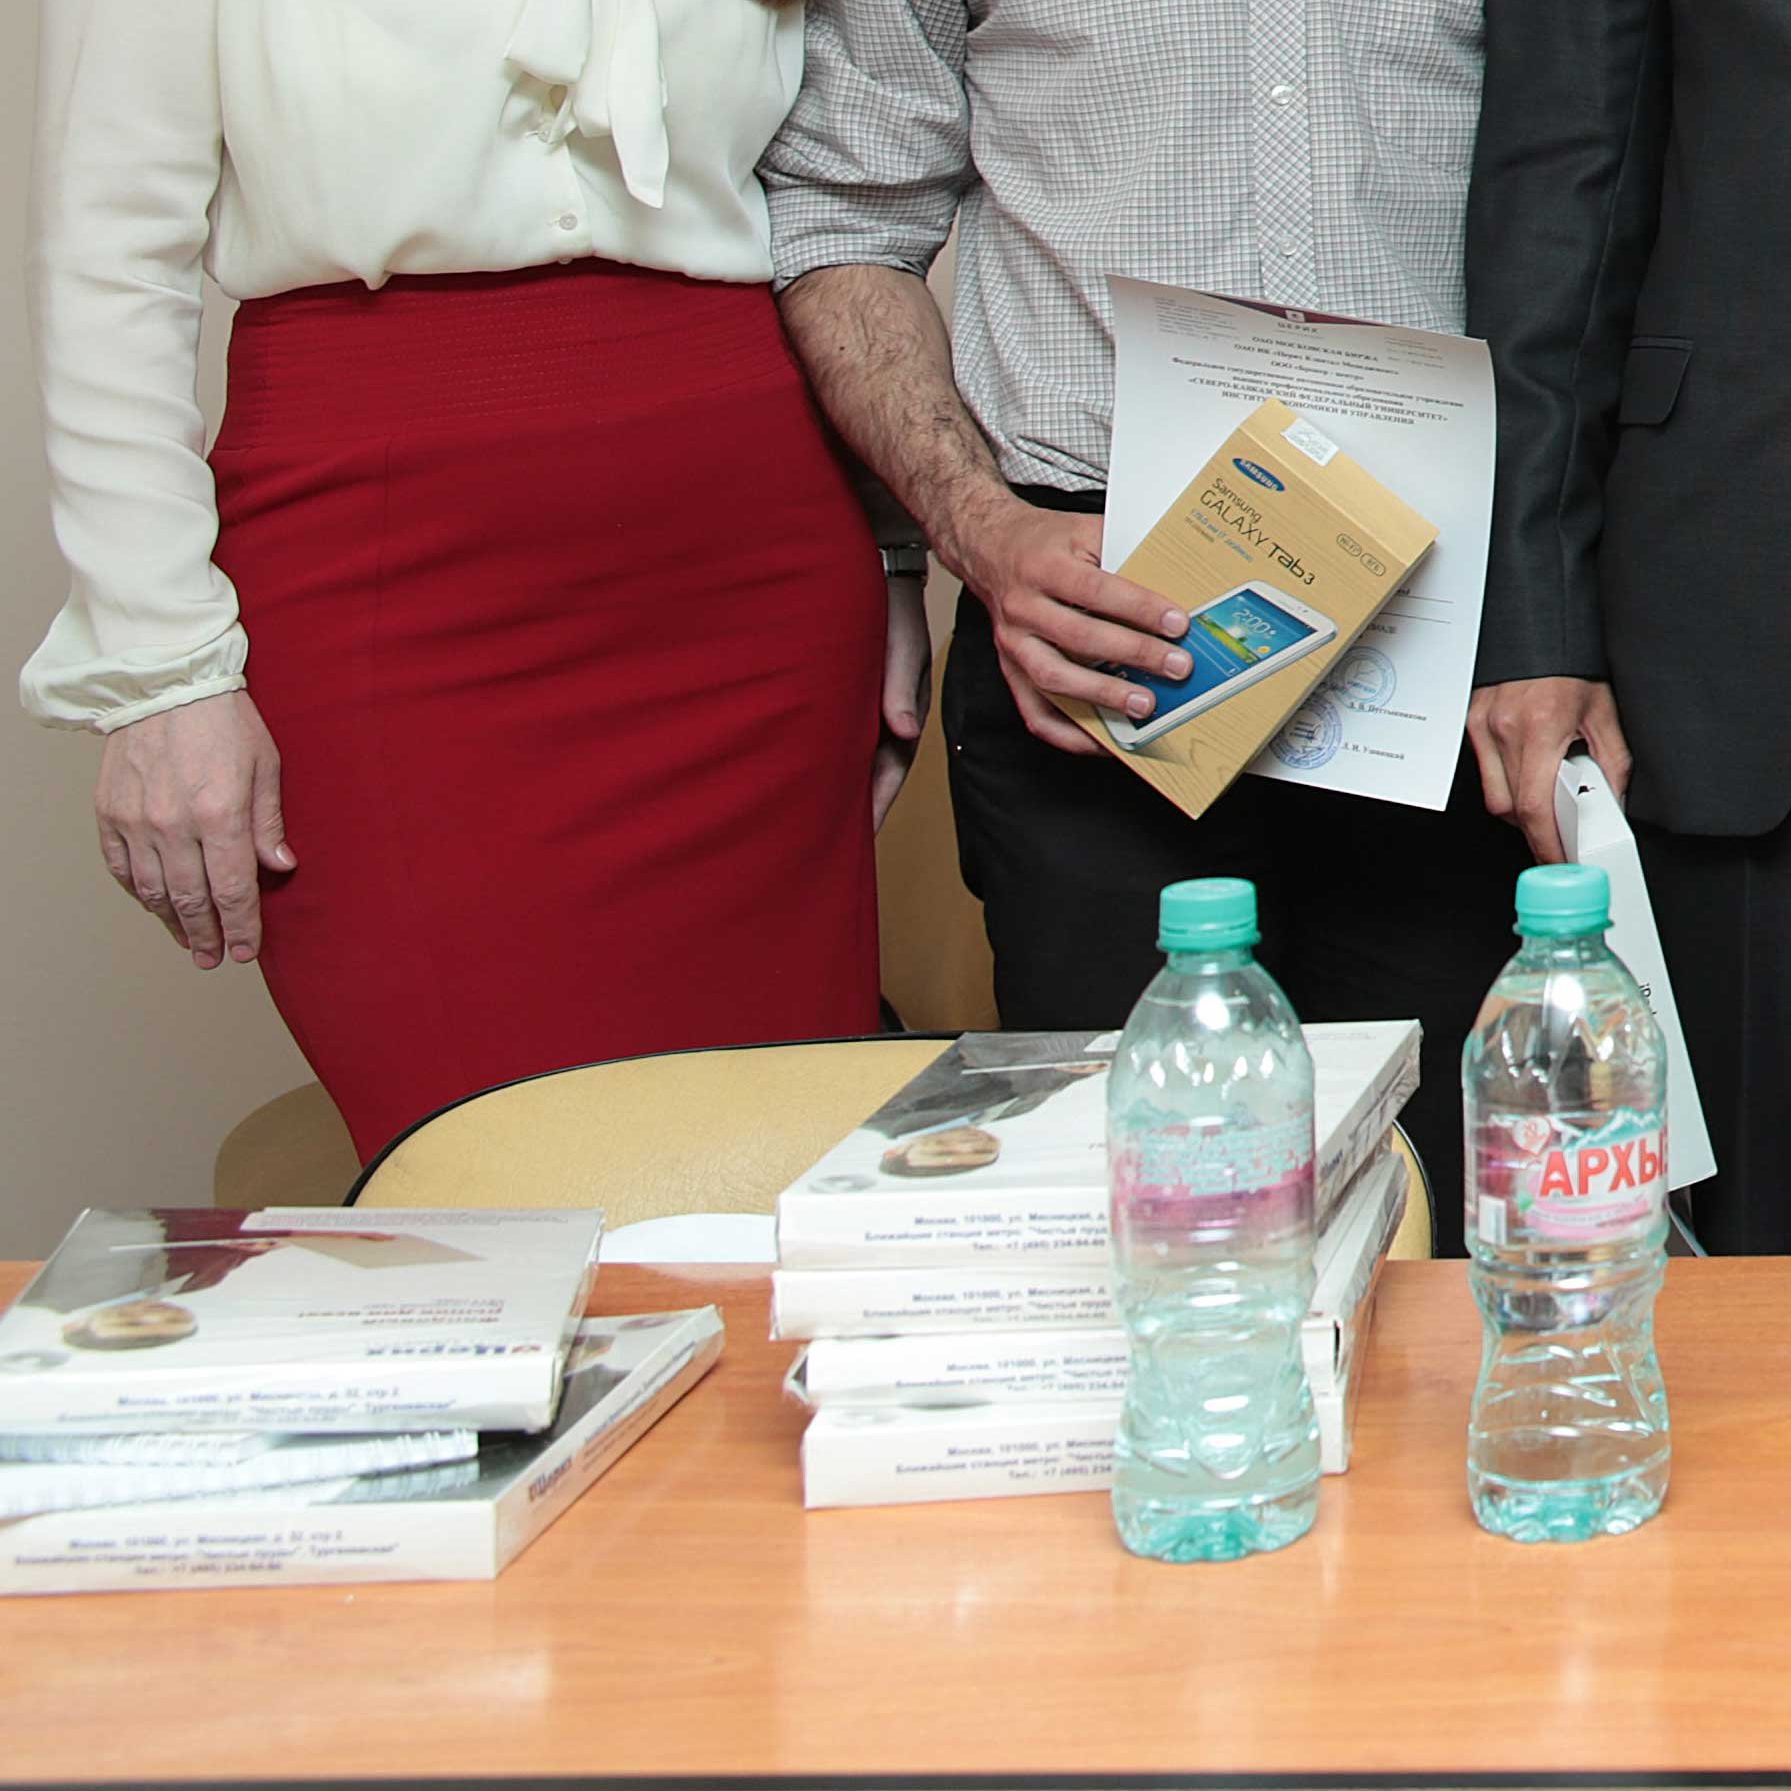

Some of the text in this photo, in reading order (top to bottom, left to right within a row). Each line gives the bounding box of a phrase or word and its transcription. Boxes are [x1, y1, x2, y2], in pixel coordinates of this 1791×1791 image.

[1211, 476, 1263, 524] Samsung
[1238, 458, 1282, 491] SAMSUNG
[1200, 489, 1269, 548] GALAXY
[1267, 542, 1306, 579] Tab
[1303, 572, 1316, 585] 3
[1539, 1136, 1666, 1199] АРХЫ
